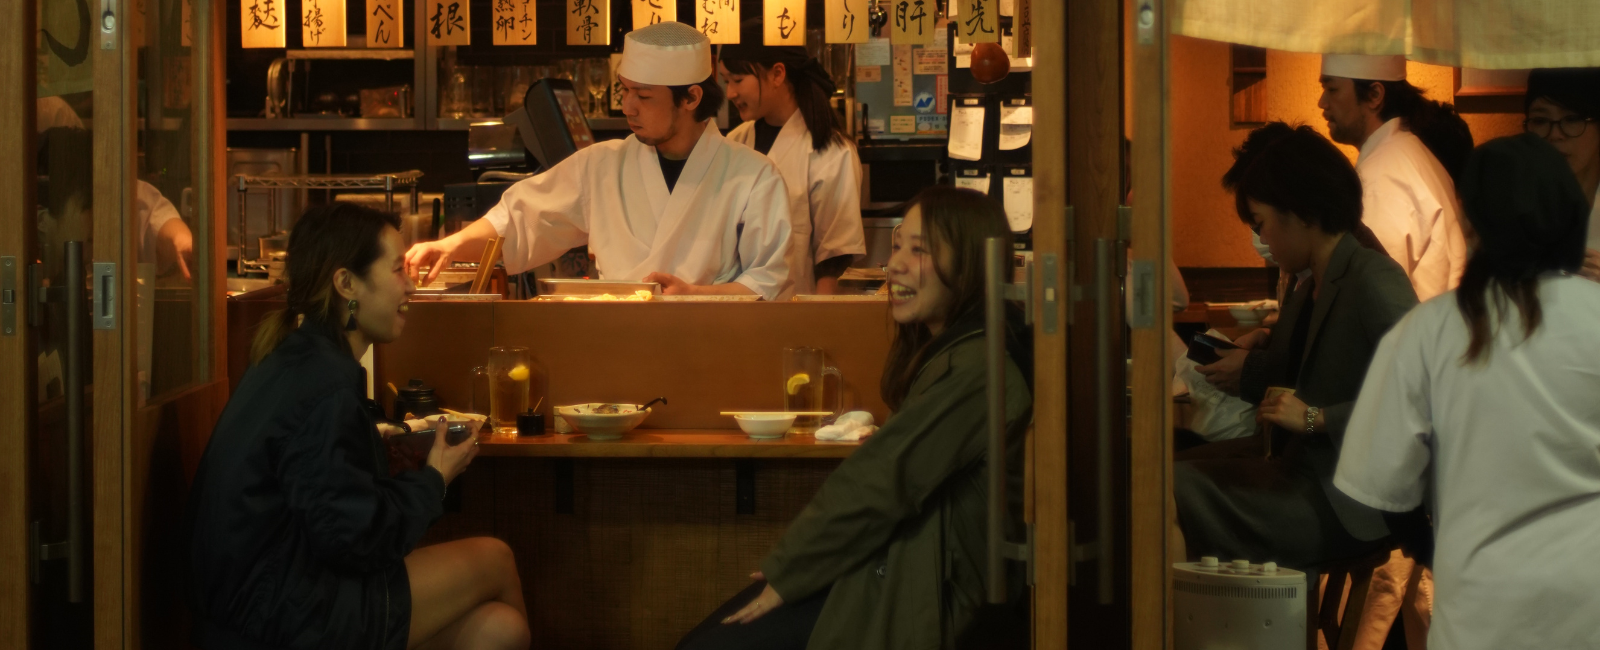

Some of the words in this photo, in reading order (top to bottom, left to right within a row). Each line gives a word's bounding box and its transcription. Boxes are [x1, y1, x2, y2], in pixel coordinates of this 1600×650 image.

[373, 0, 394, 44] ぺん
[430, 2, 465, 39] 根
[572, 0, 599, 44] 軟骨
[776, 7, 797, 39] も
[895, 1, 928, 35] 肝
[966, 0, 994, 36] 先
